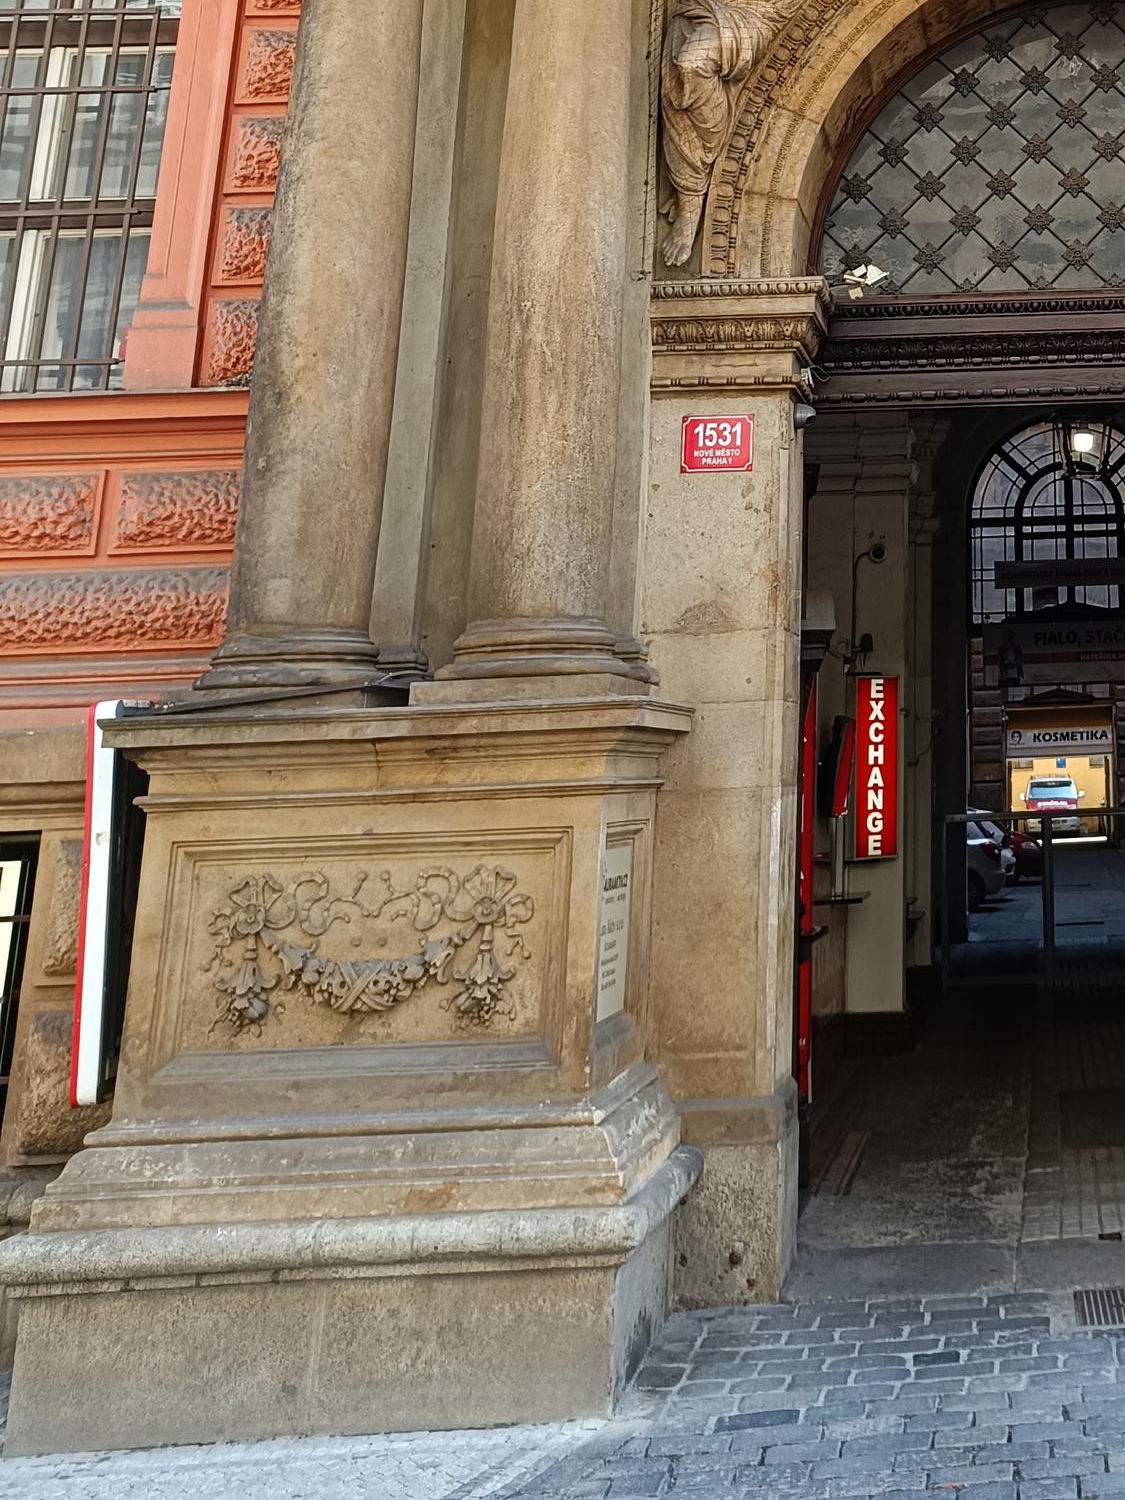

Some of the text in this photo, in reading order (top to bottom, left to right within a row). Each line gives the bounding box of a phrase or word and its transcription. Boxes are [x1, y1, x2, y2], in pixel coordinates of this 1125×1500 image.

[694, 422, 742, 447] 1531
[694, 447, 741, 457] NOVÉ MĚSTO
[701, 457, 727, 465] PRAHA
[1034, 630, 1081, 646] FIALO,
[1033, 730, 1108, 743] KOSMETIKA
[866, 679, 885, 856] EXCHANGE
